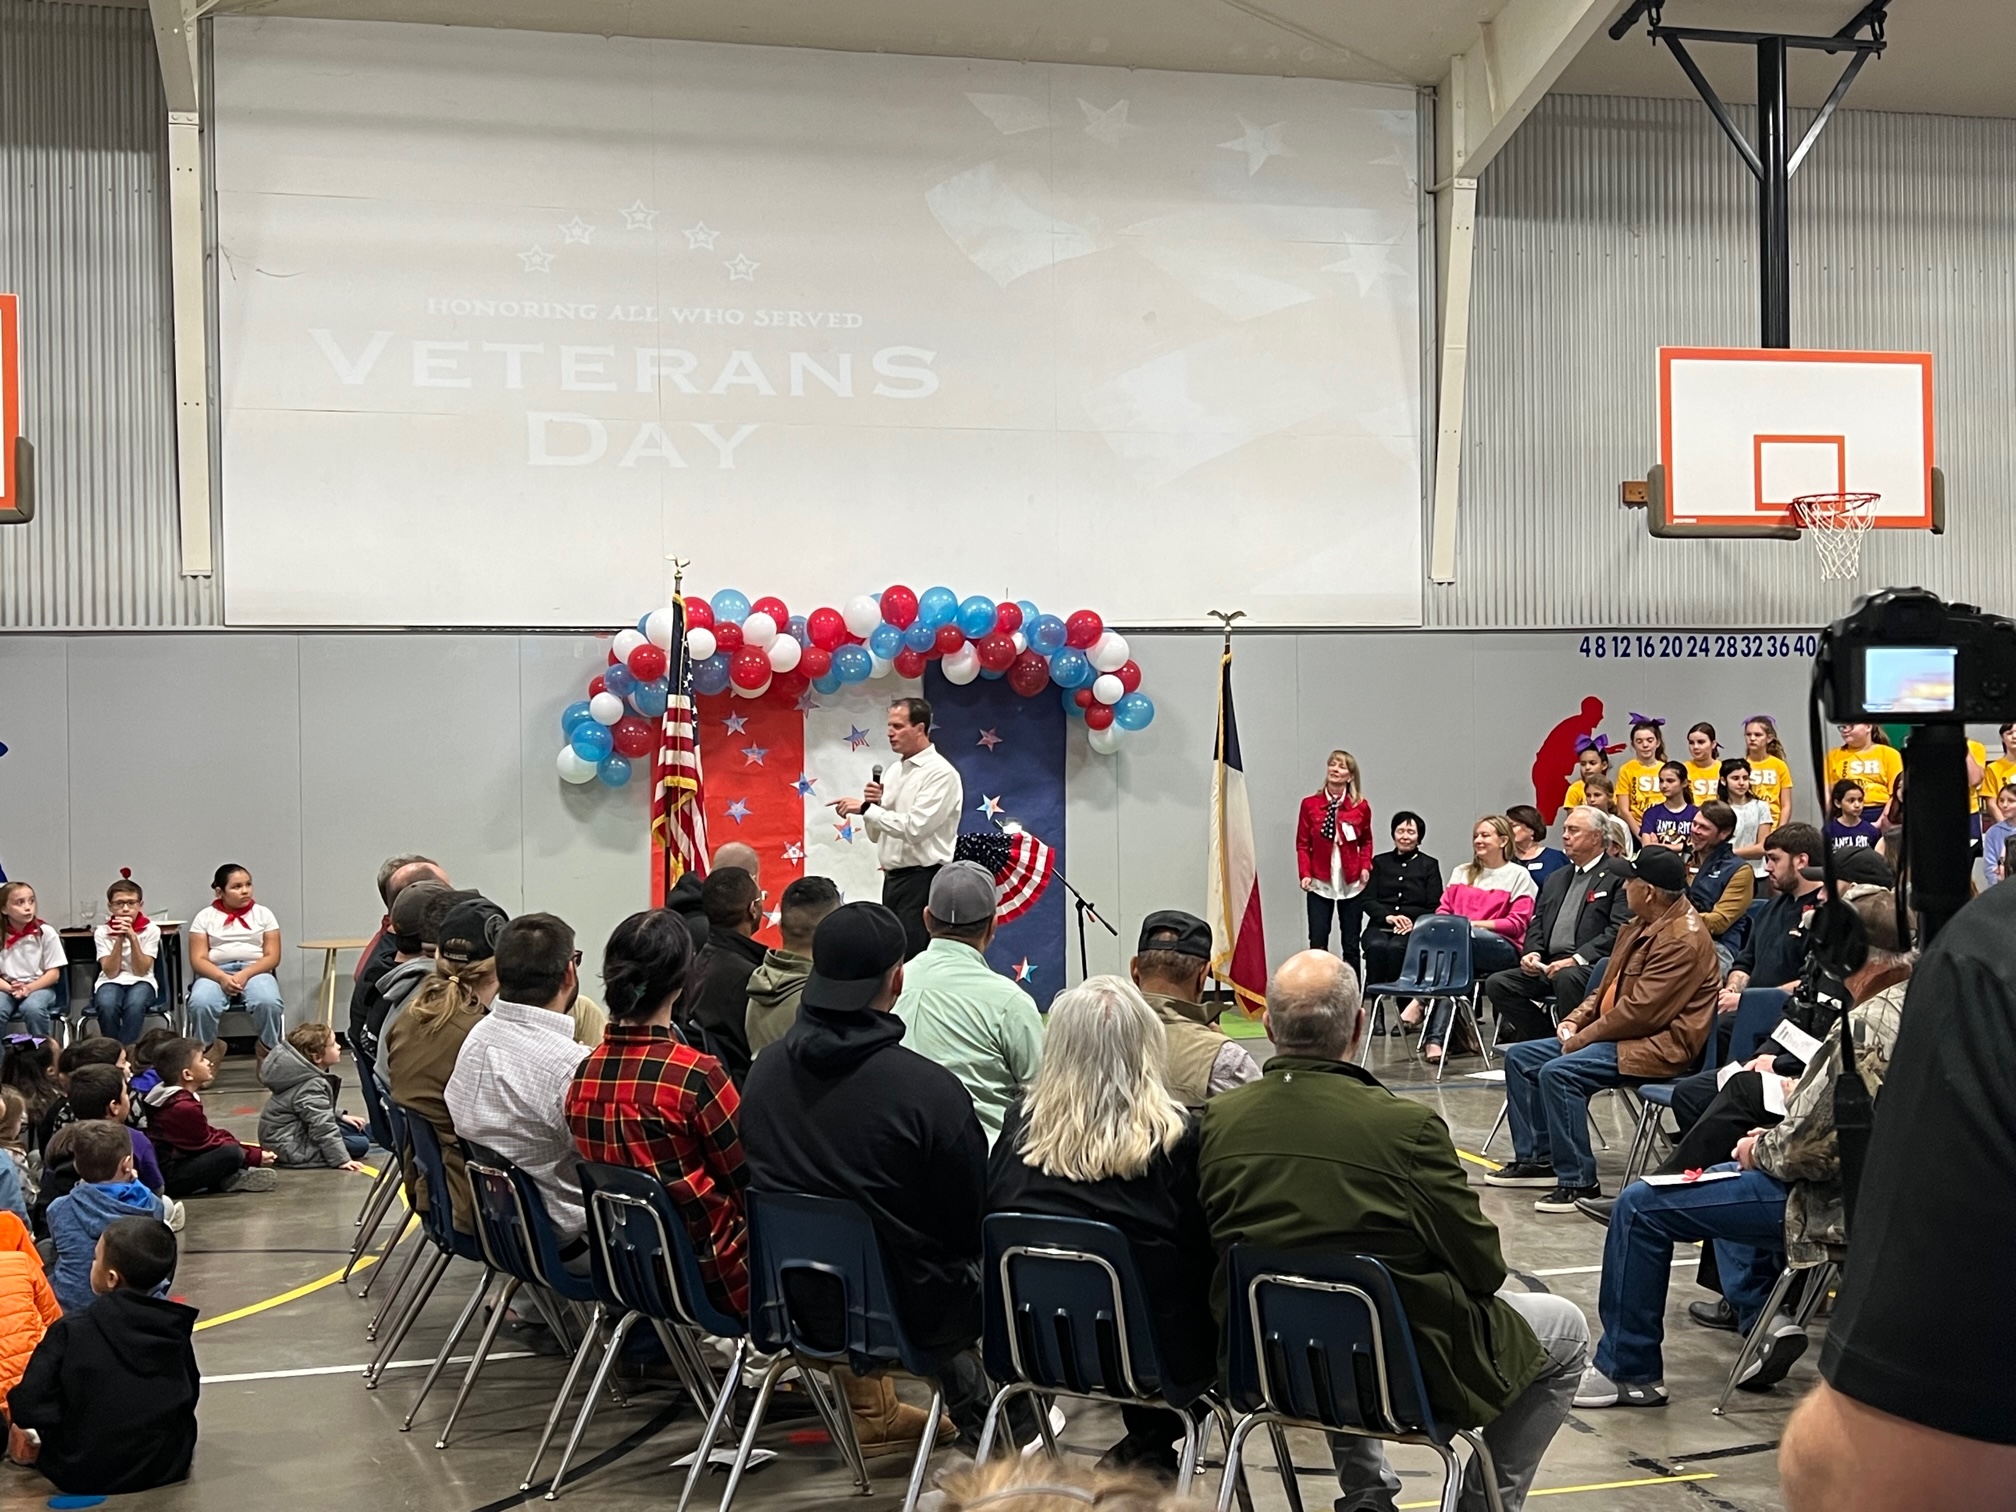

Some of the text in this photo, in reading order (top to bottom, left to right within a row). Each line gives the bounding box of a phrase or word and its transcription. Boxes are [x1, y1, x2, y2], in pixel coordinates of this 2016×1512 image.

[427, 297, 864, 329] HONORING ALL WHO SERVED
[307, 328, 940, 399] VETERANS
[526, 411, 760, 470] DAY
[1580, 635, 1816, 658] 4 8 12 16 20 24 28 32 36 40
[1749, 769, 1777, 785] SR
[1849, 760, 1880, 775] SR
